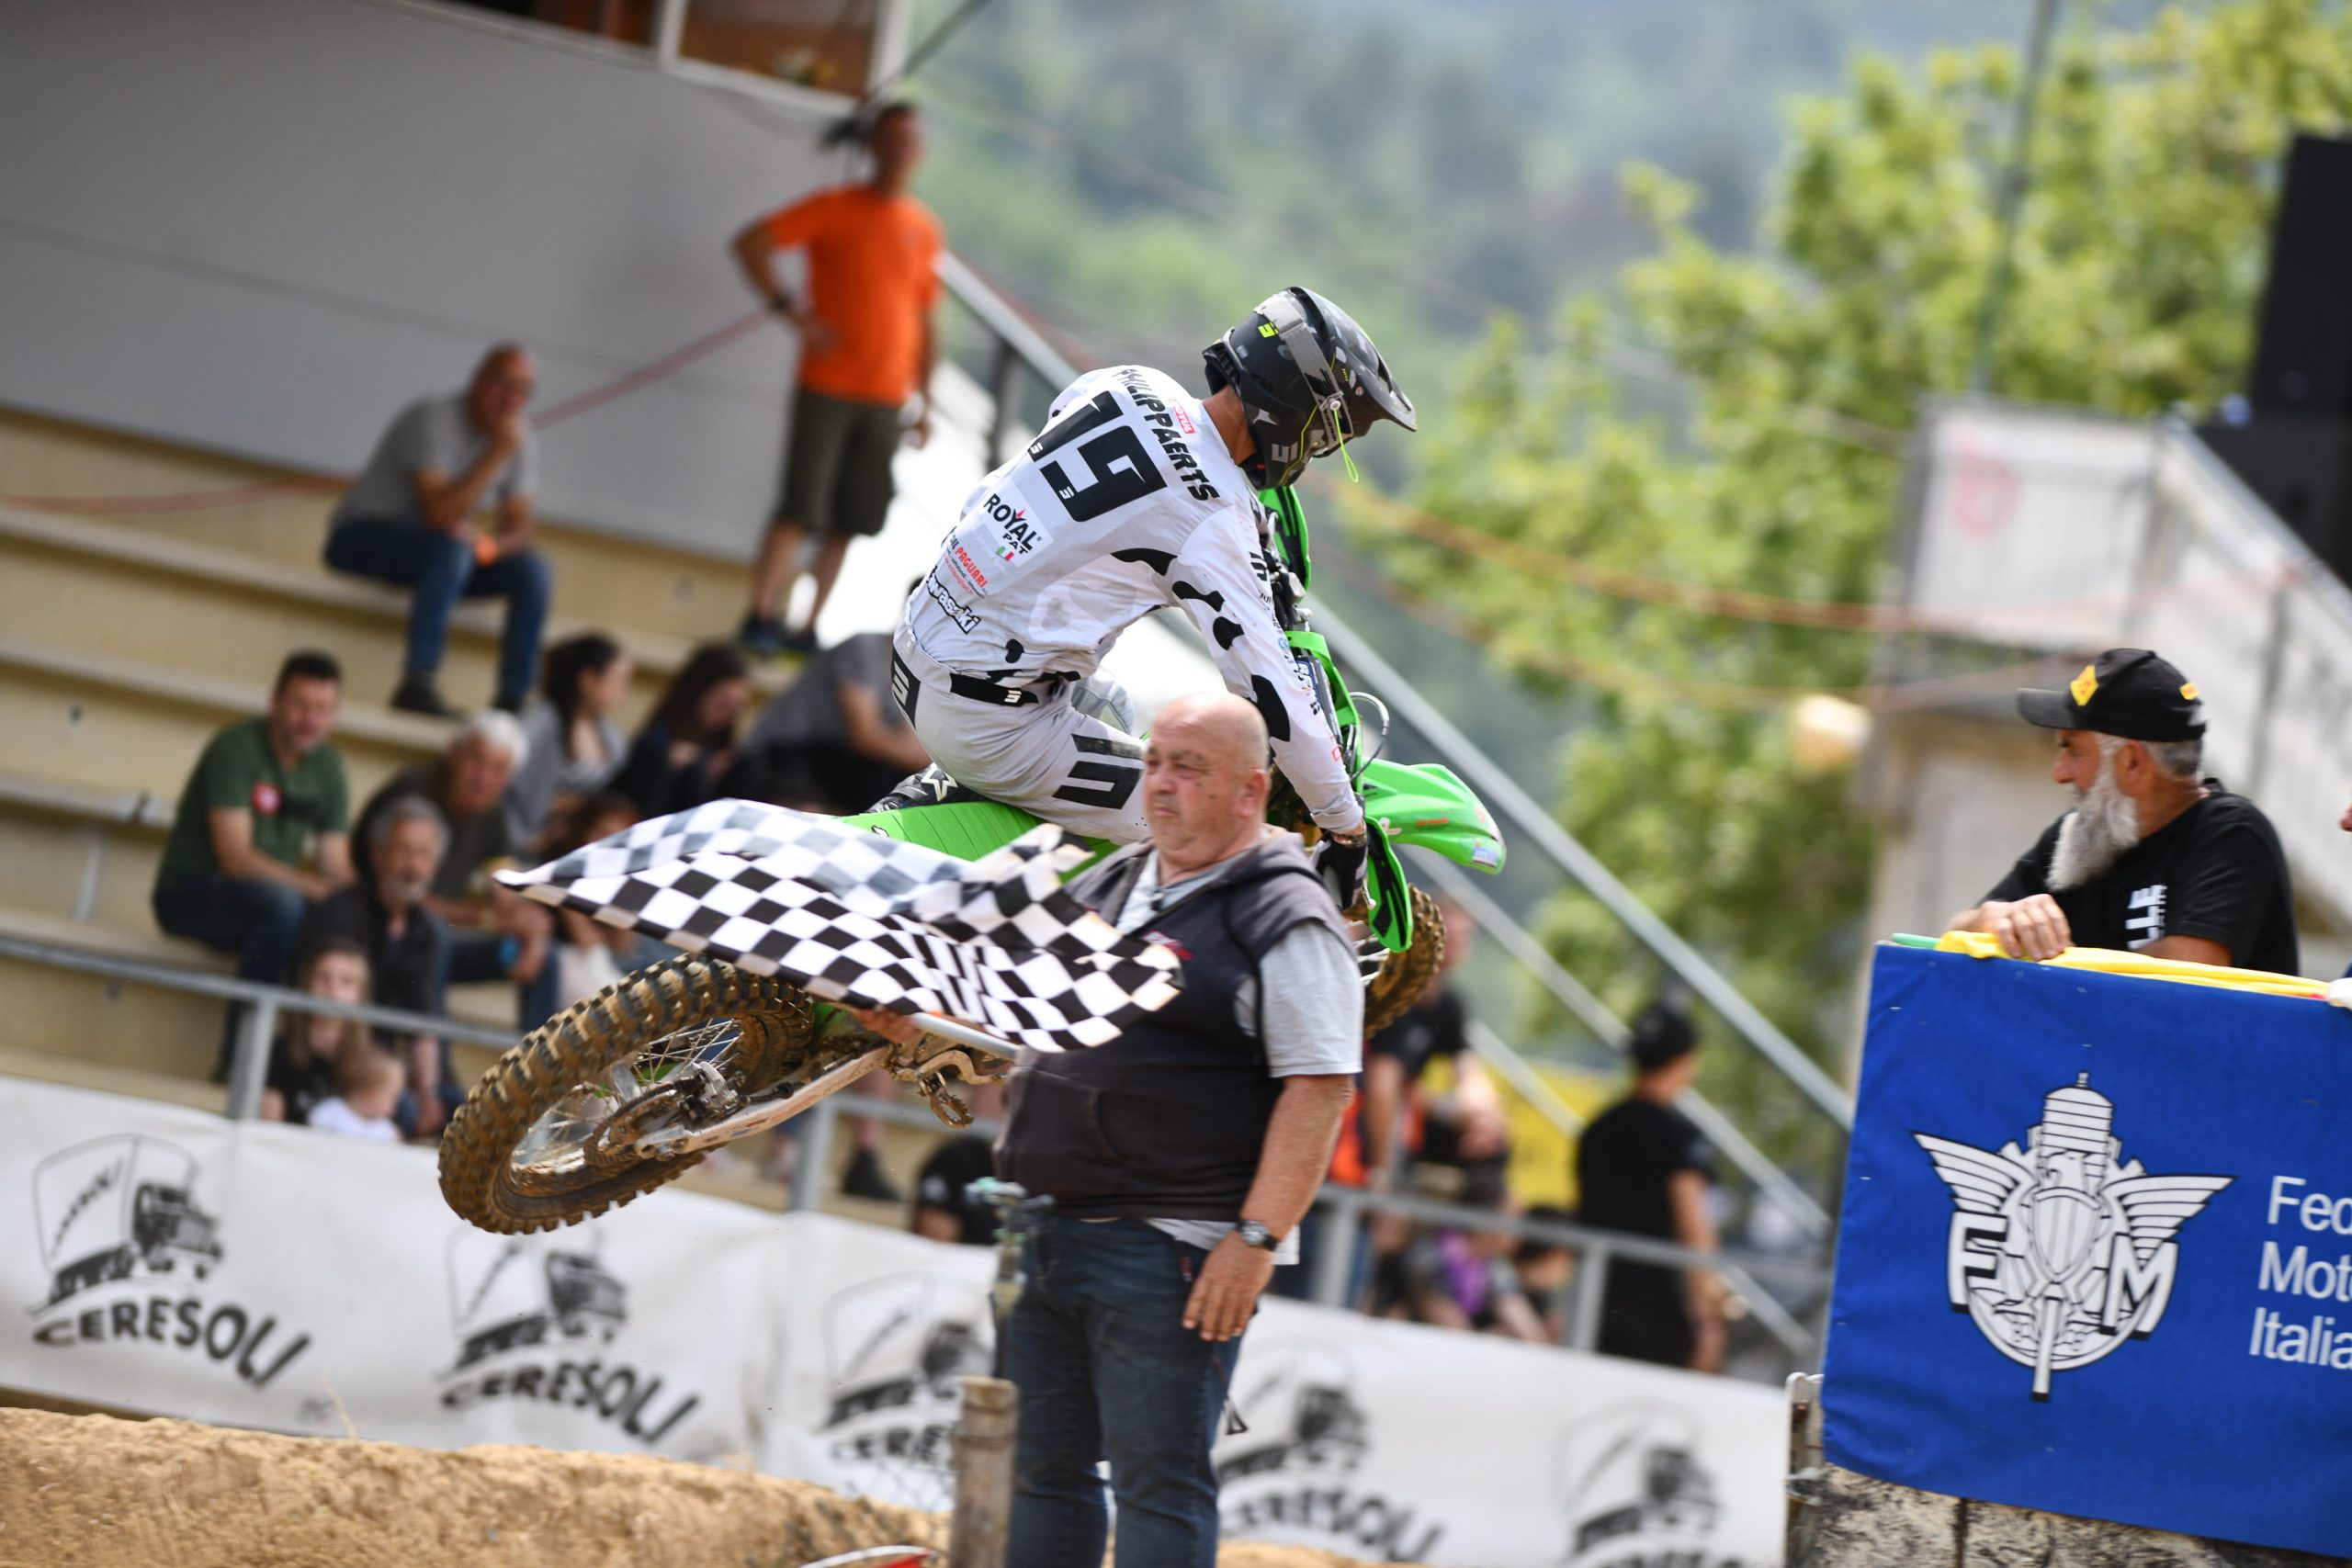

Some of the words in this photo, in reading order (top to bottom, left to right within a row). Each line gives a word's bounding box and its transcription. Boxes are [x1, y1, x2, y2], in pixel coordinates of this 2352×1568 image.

[1028, 390, 1168, 522] 19
[983, 493, 1036, 551] ROYAL
[1002, 533, 1028, 555] PAT
[926, 565, 981, 635] wasaki
[2257, 1240, 2352, 1302] Mot
